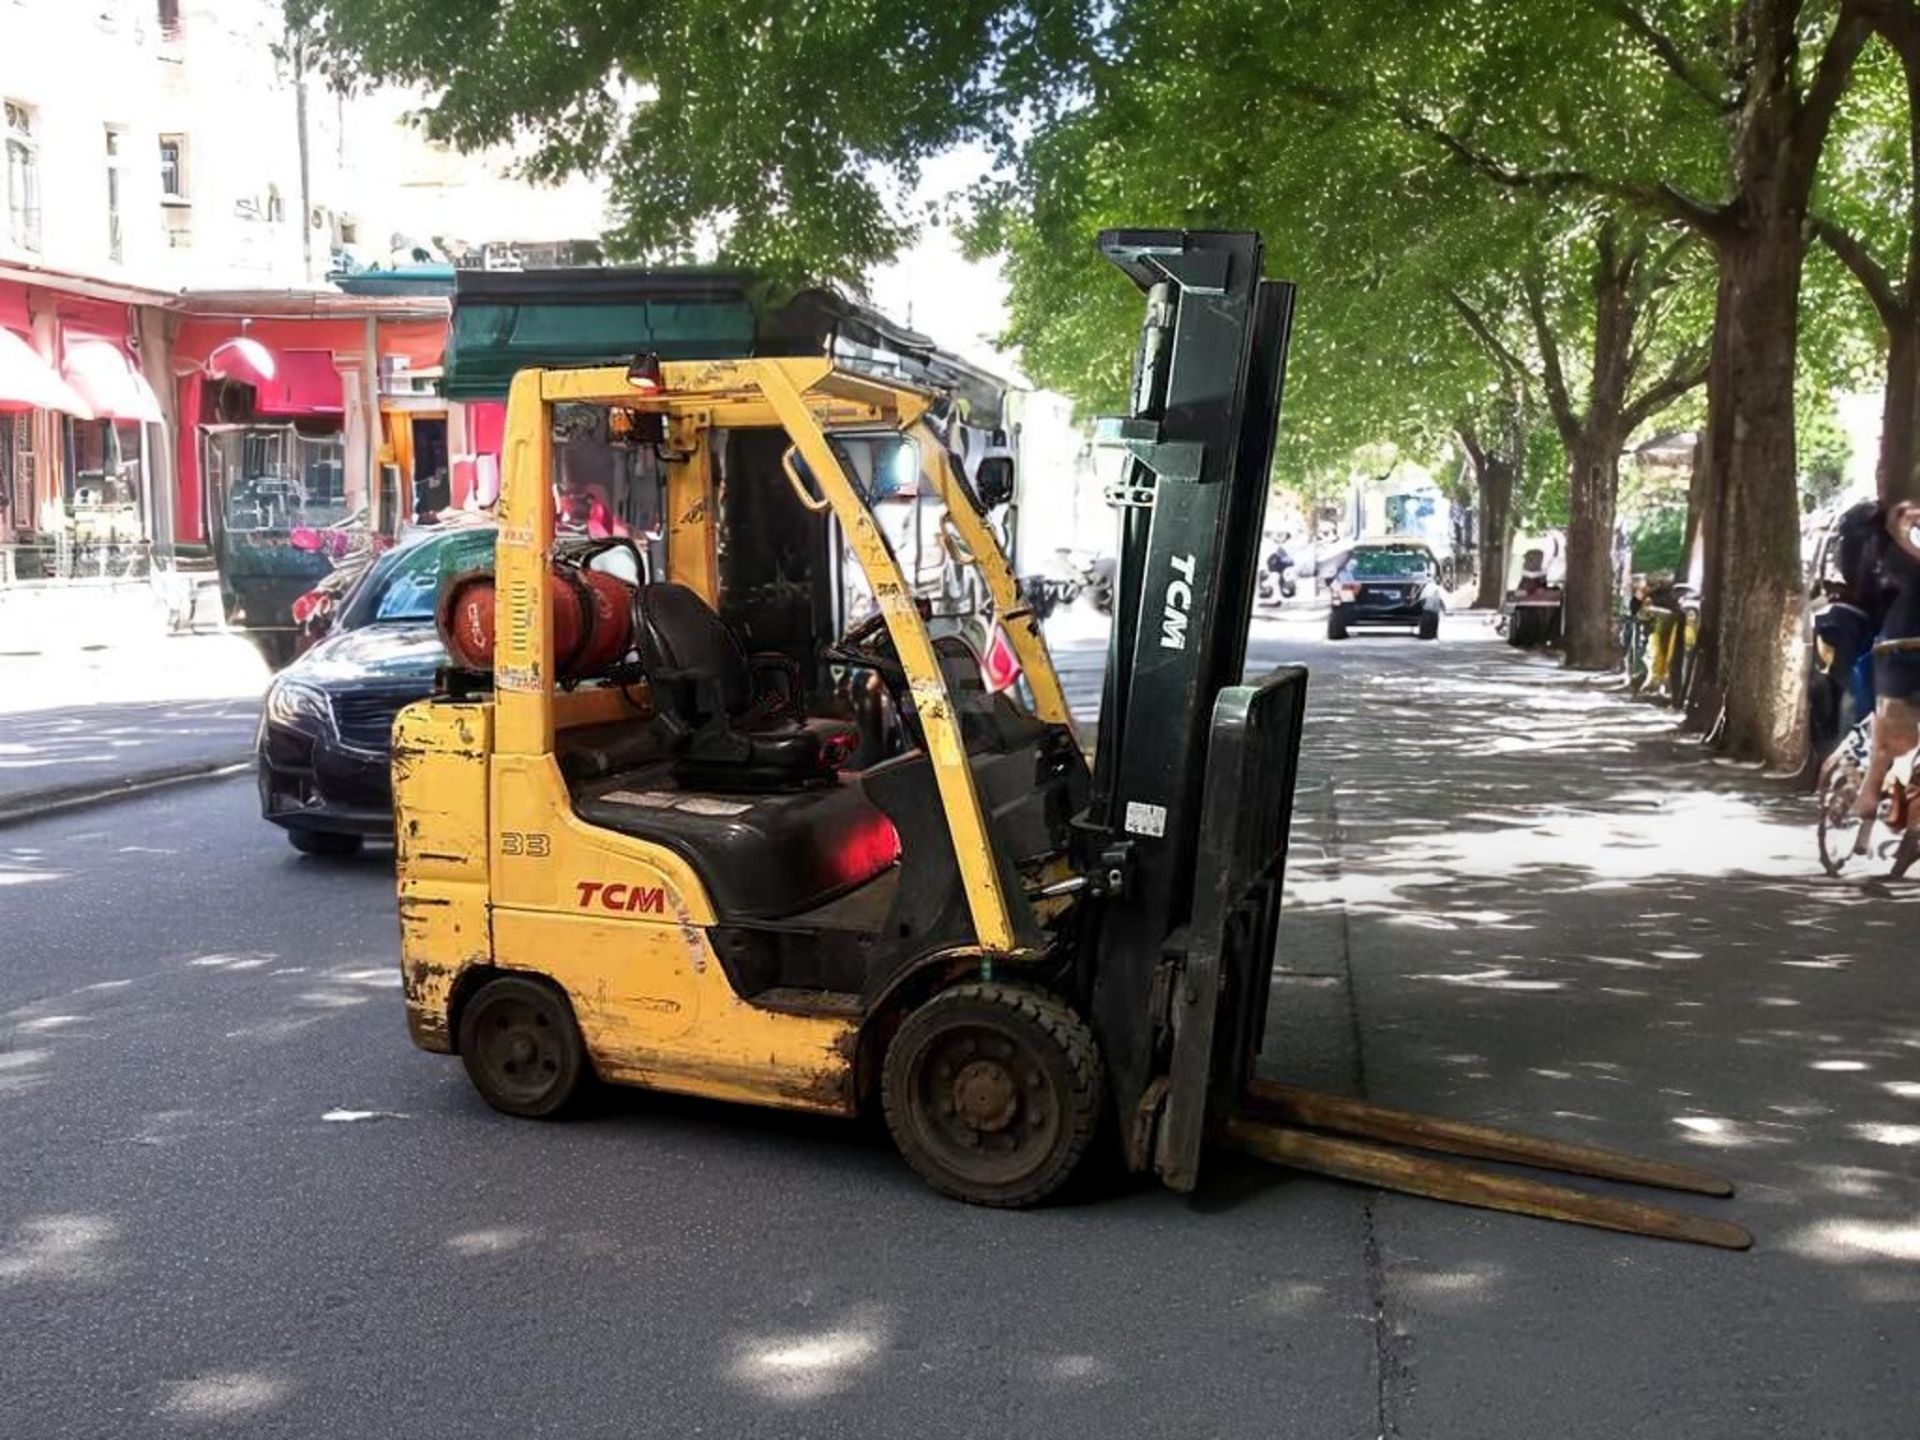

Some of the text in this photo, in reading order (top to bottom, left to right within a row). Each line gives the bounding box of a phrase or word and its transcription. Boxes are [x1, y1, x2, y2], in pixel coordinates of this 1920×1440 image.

[1160, 553, 1196, 650] TCM
[501, 831, 551, 857] 33
[577, 881, 665, 914] TCM
